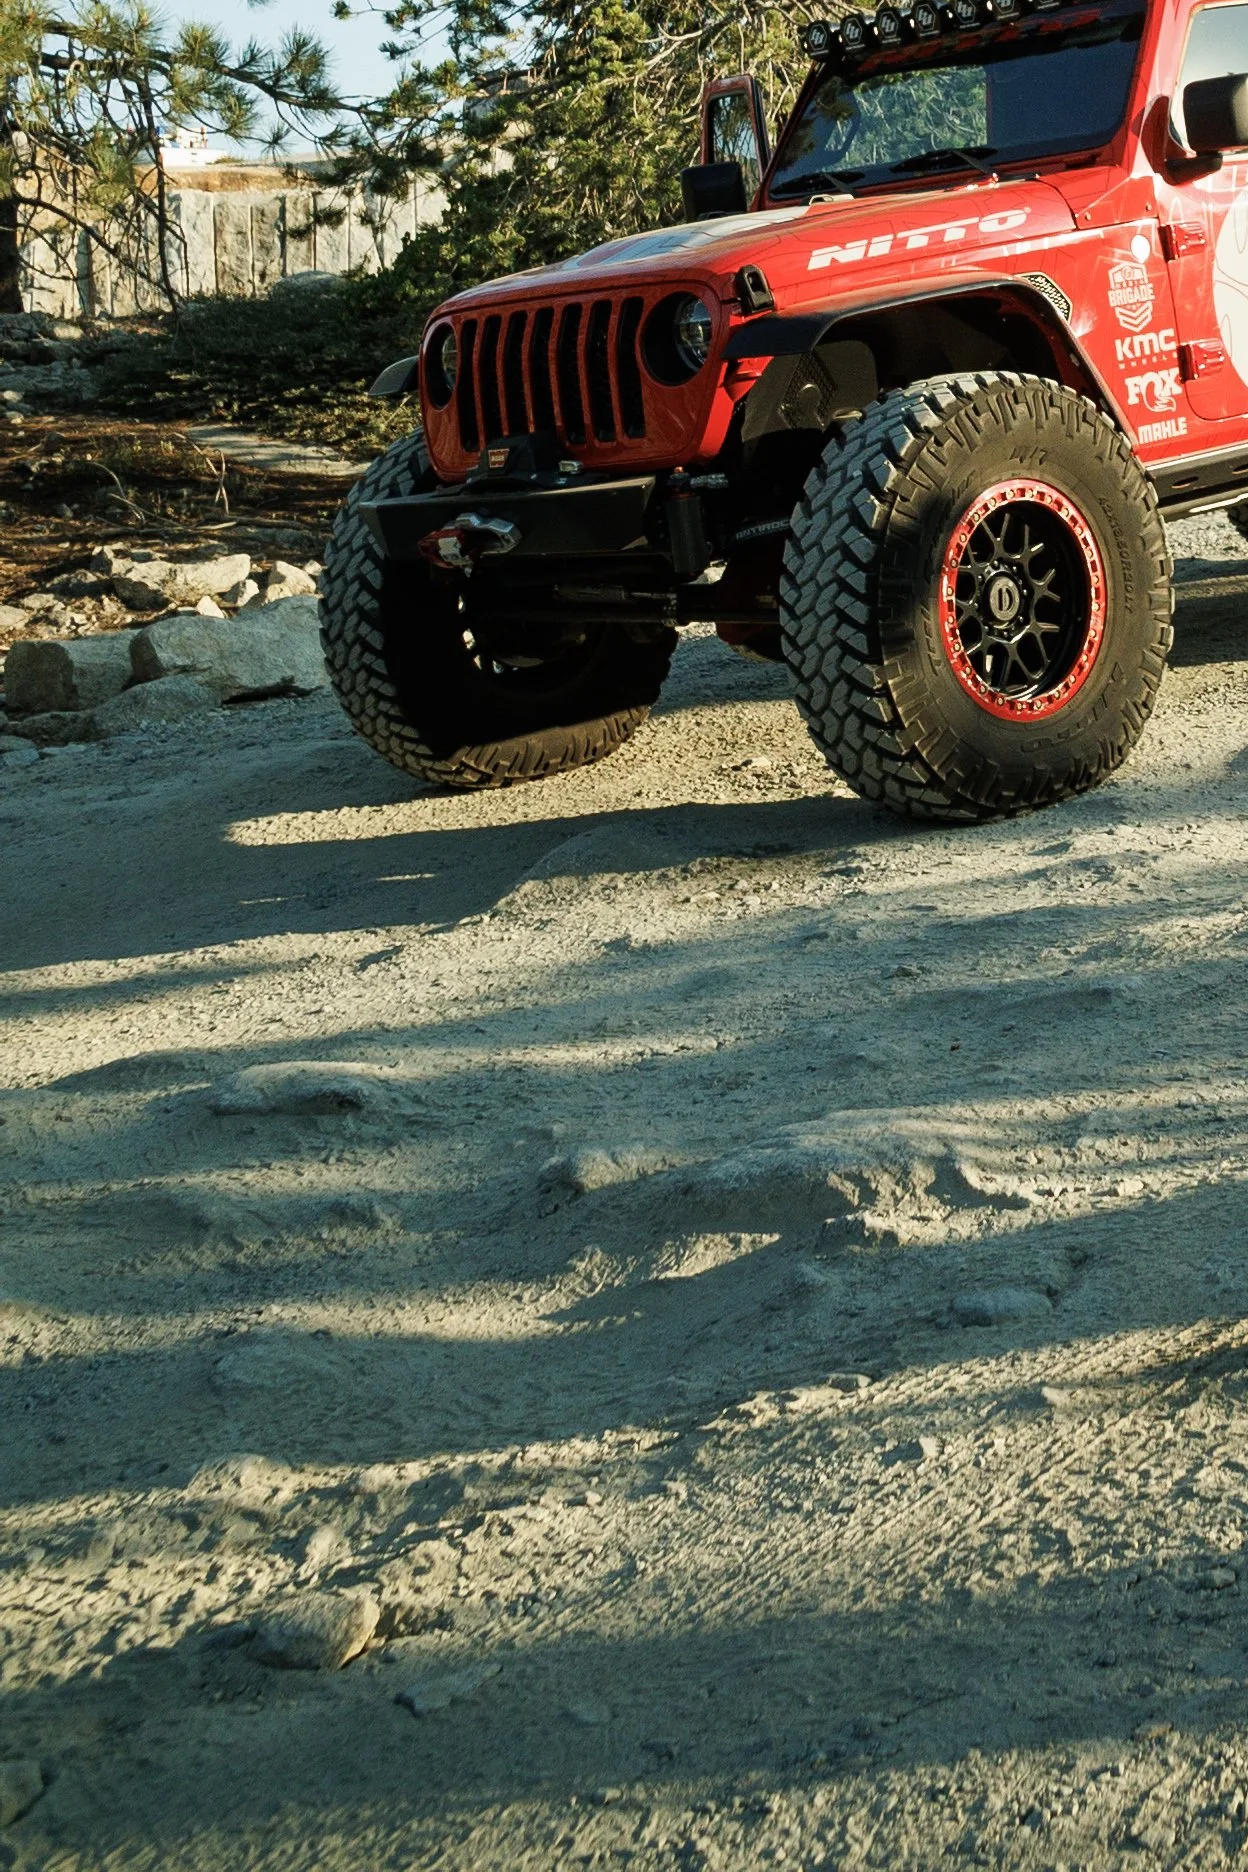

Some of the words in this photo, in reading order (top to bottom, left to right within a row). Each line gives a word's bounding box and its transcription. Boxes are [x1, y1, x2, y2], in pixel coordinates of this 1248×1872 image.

[806, 209, 1029, 271] NITTO
[1108, 282, 1155, 307] BRIGADE
[1115, 328, 1177, 361] KMC
[1124, 367, 1183, 412] FOX
[1138, 416, 1188, 445] MAHLE
[736, 518, 791, 540] ANTIROC
